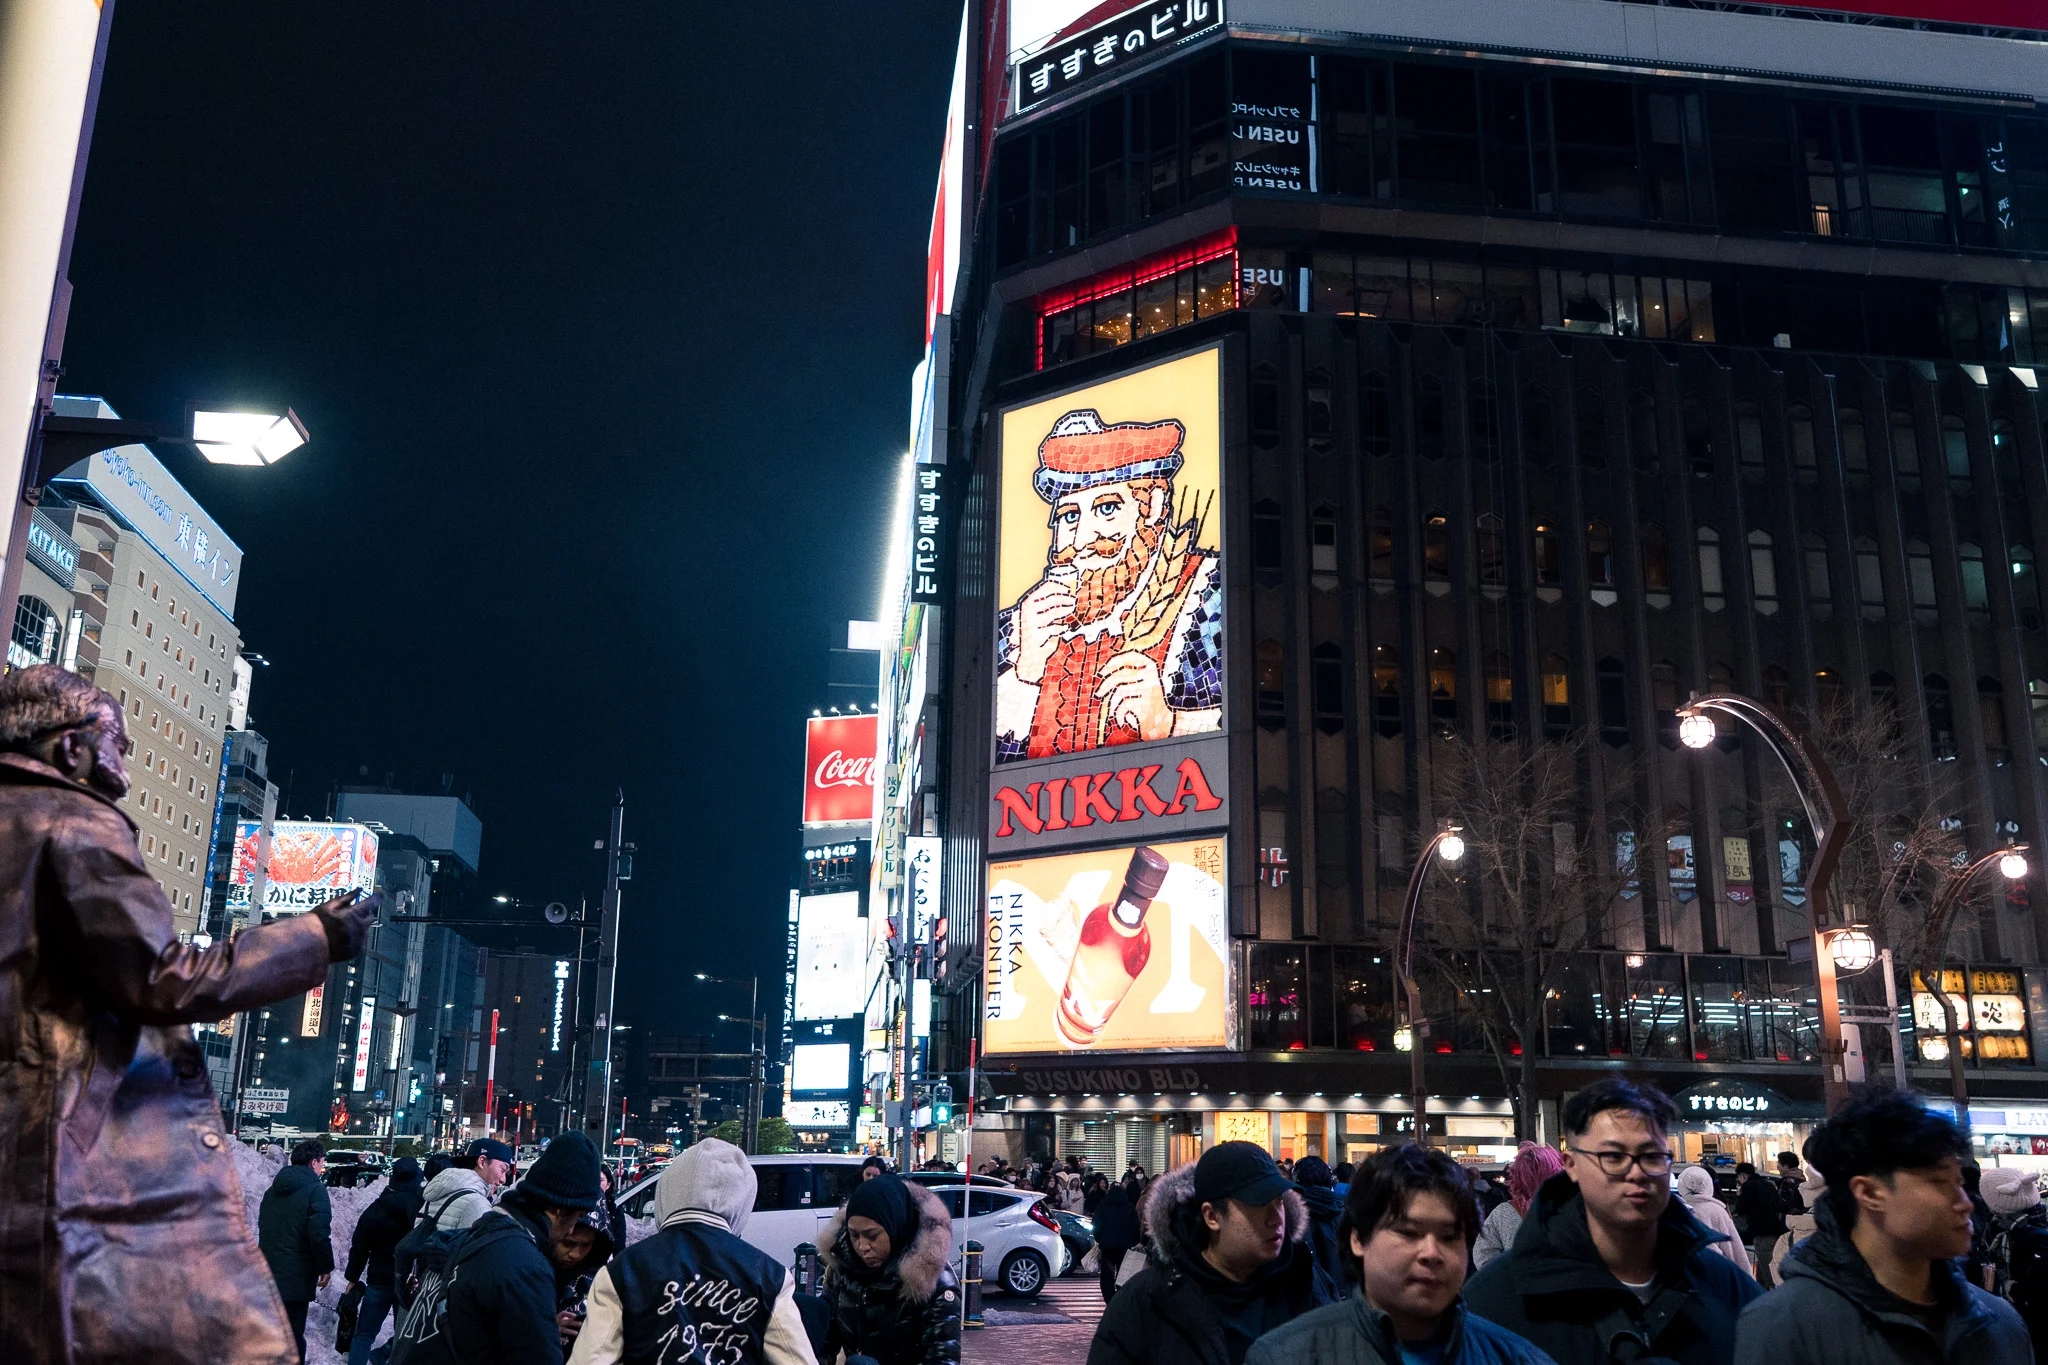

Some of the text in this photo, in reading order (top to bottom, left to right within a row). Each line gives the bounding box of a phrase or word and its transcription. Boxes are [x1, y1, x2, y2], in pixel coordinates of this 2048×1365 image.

[1029, 0, 1209, 94] すすきのビル
[174, 512, 234, 587] 東横イン
[915, 470, 941, 594] すすきのビル
[993, 757, 1224, 838] NIKKA
[986, 895, 1004, 1019] FRONTIER
[1008, 893, 1023, 975] NIKKA
[1022, 1067, 1209, 1092] SUSUKINO BLD.
[1689, 1095, 1769, 1112] すすきのビル
[657, 1273, 759, 1324] since
[657, 1321, 749, 1365] 1975
